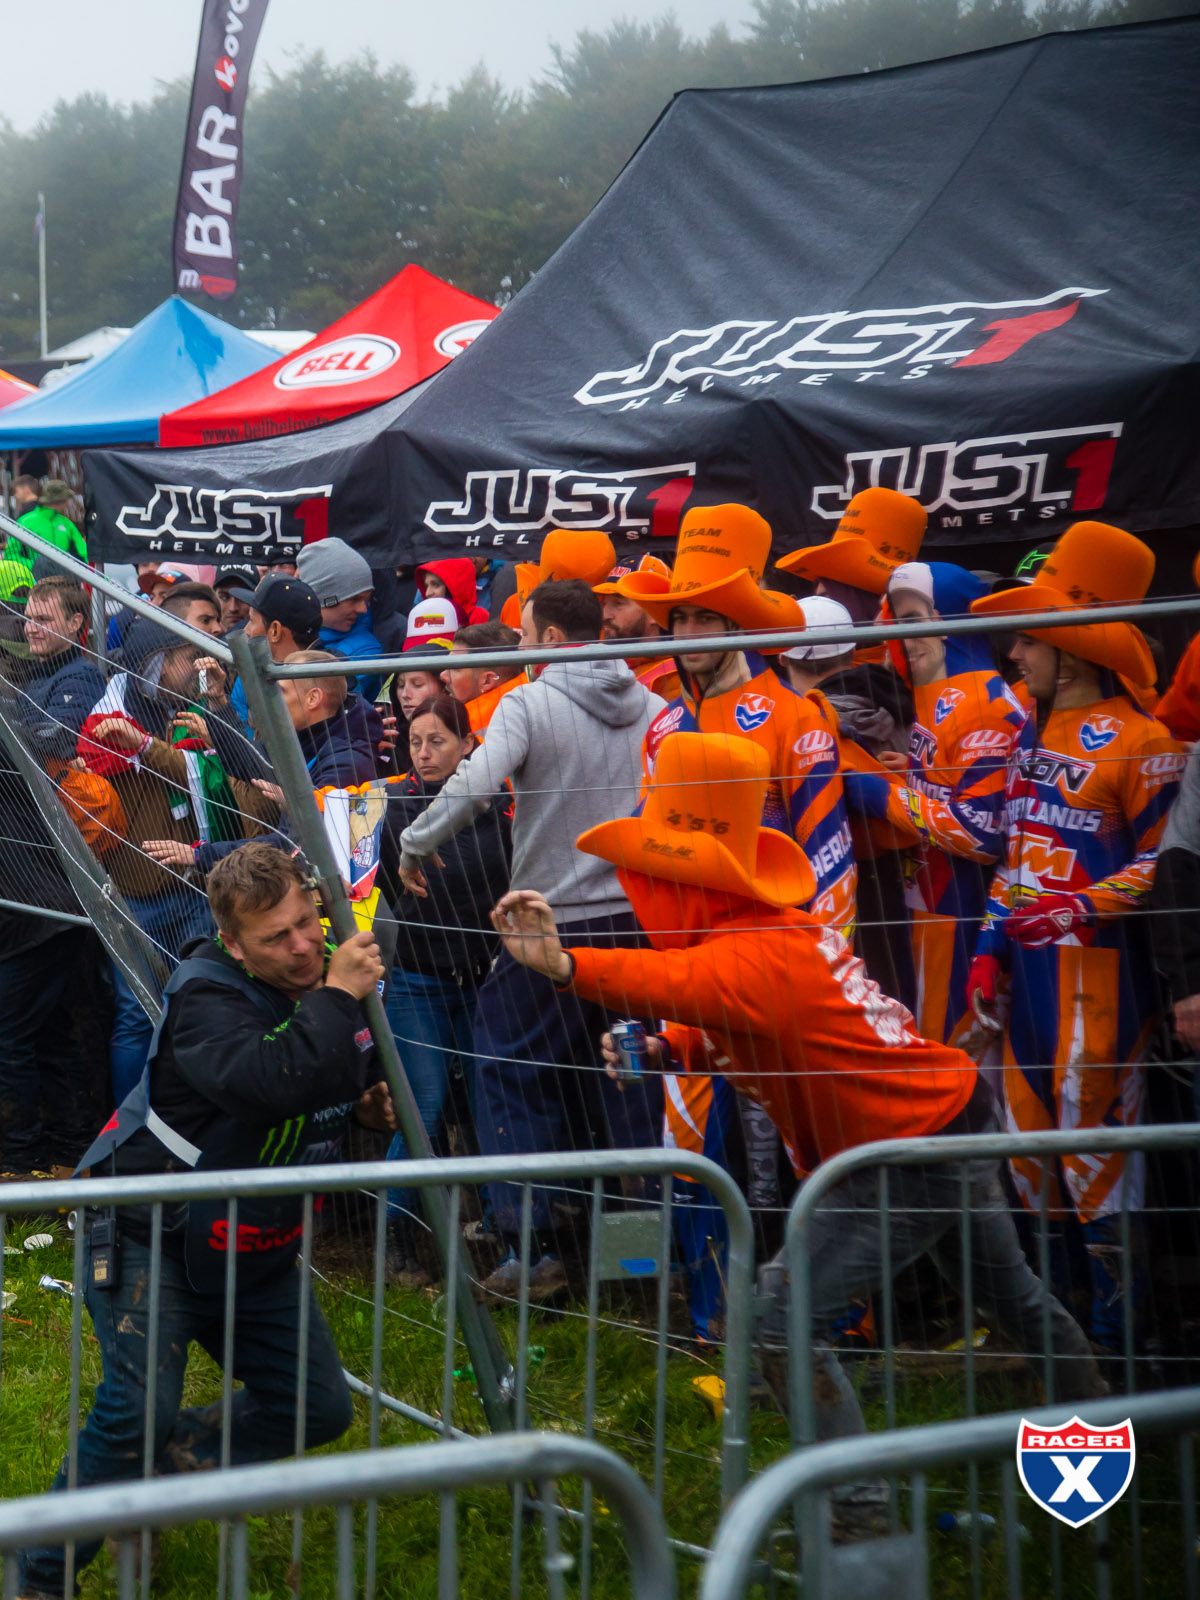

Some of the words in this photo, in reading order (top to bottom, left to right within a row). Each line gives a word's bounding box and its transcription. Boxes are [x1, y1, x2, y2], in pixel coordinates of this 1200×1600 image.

[185, 105, 238, 258] BAR
[294, 350, 375, 378] BELL
[618, 363, 934, 412] HELMETS
[941, 505, 1057, 528] METS
[683, 528, 722, 539] TEAM
[150, 540, 296, 558] HELMETS
